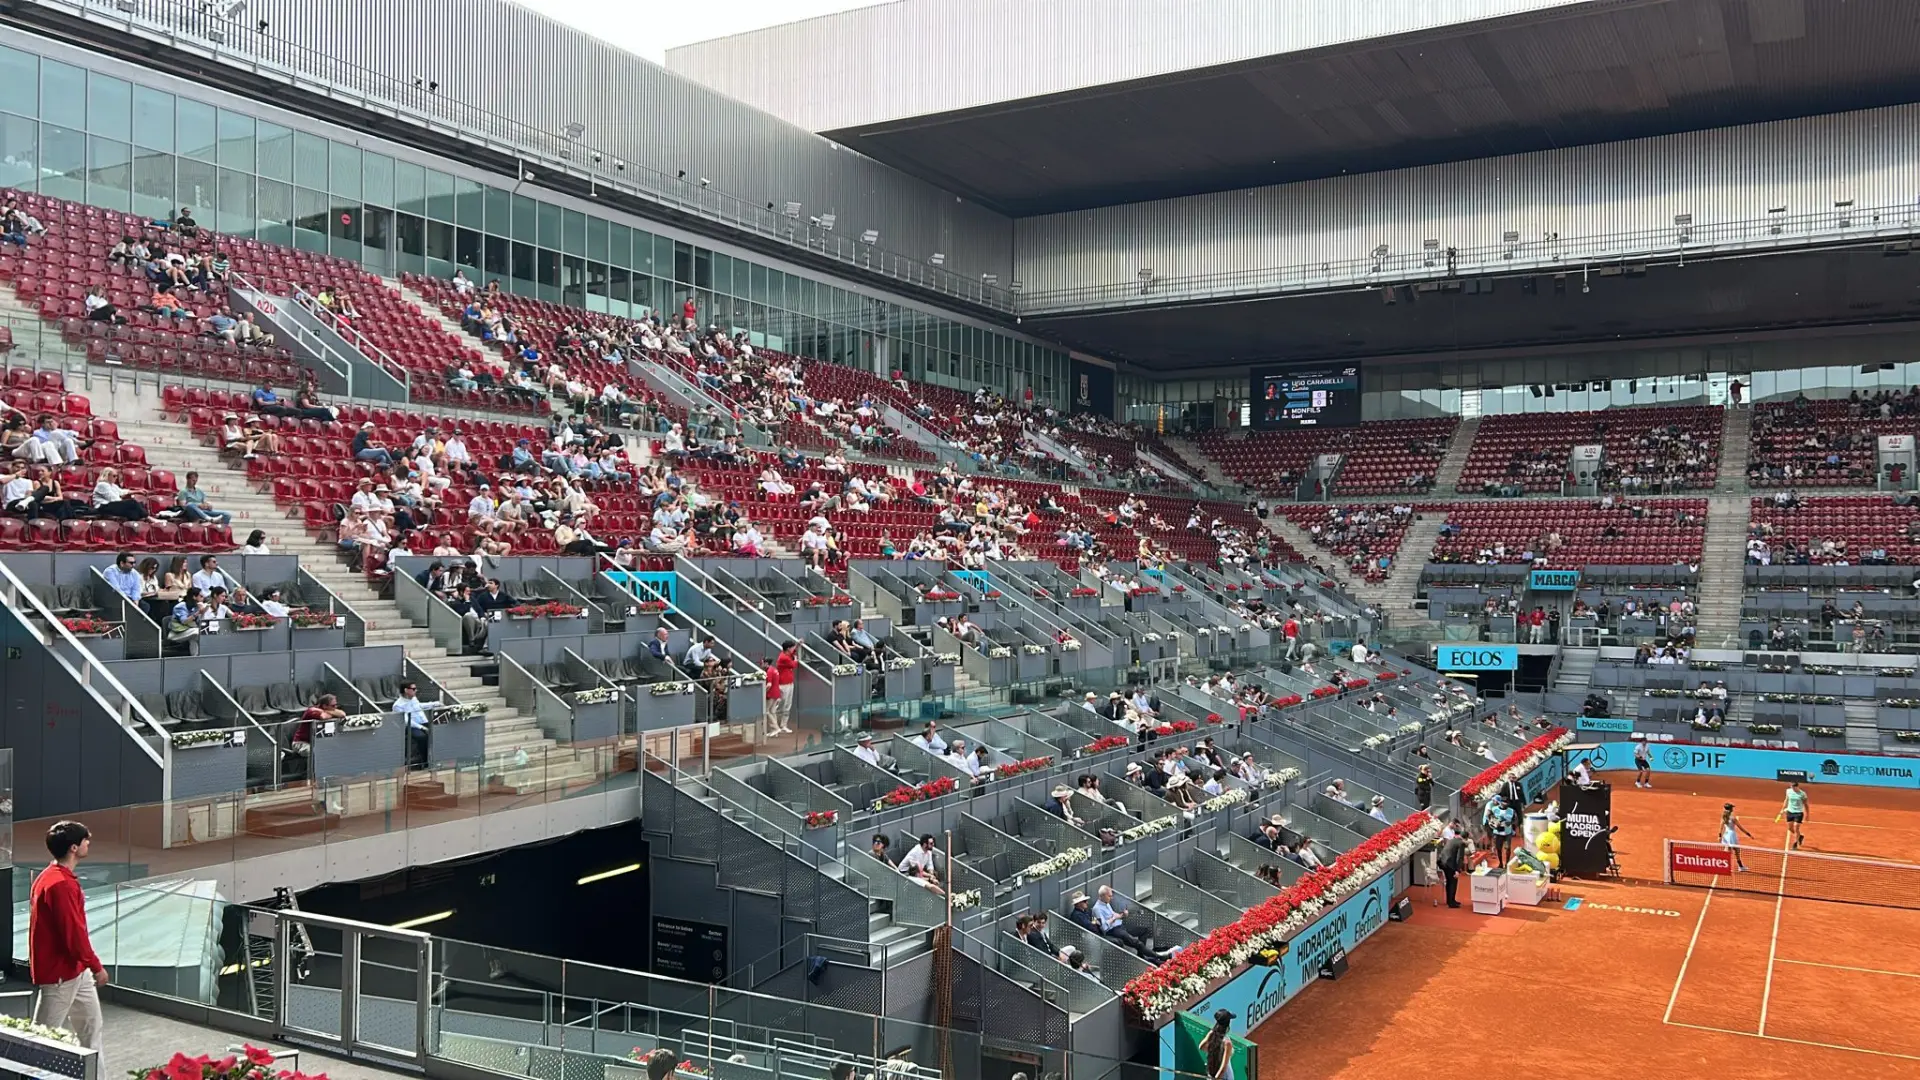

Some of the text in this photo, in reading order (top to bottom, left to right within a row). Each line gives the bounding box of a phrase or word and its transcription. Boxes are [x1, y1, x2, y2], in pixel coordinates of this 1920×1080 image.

[1307, 378, 1344, 386] CARABELLI
[152, 436, 164, 445] 12
[1534, 574, 1576, 586] MARCA
[1451, 650, 1502, 666] ECLOS
[1596, 722, 1629, 730] SCORES
[1691, 751, 1727, 769] PIF
[1566, 813, 1599, 824] MUTUA
[1565, 822, 1601, 831] MADRID
[1570, 829, 1597, 838] OPEN
[1675, 853, 1729, 868] Emirates
[1474, 885, 1494, 894] Polaroid
[1588, 902, 1681, 917] MADRID
[1296, 909, 1348, 966] HIDRATACIÓN
[1246, 982, 1287, 1030] Electrolit
